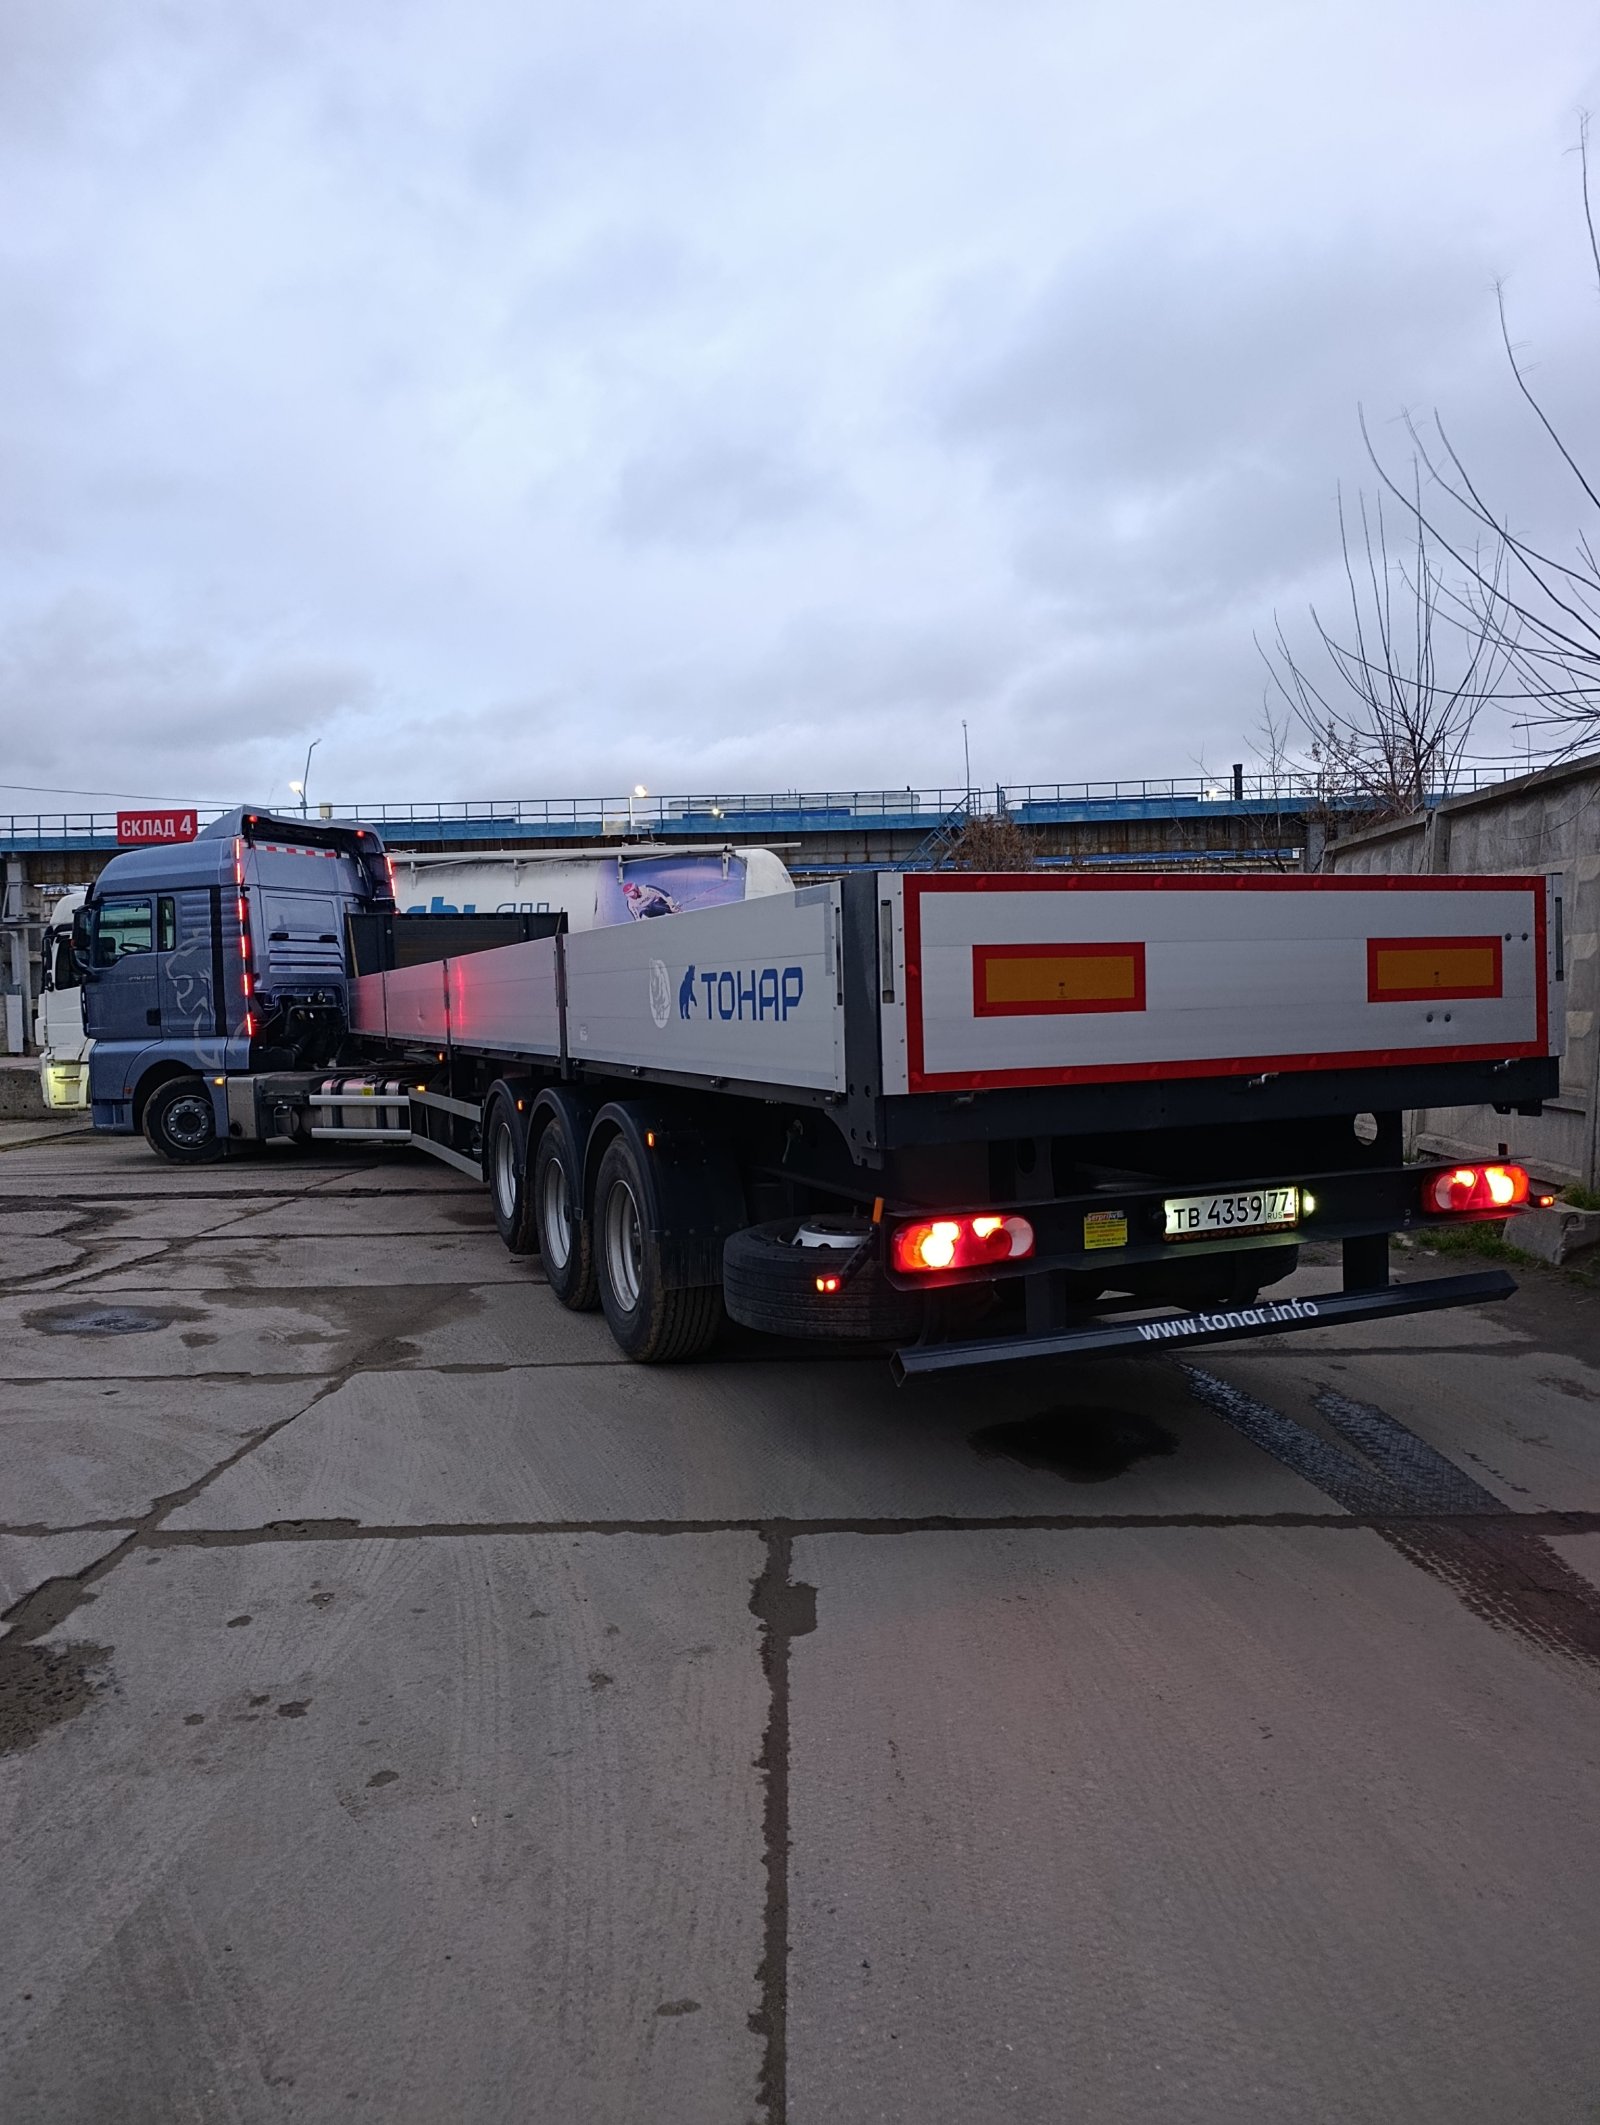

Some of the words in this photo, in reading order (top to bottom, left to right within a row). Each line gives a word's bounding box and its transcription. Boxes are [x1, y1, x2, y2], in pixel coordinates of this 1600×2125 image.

[121, 819, 176, 837] СКЛАД
[180, 815, 193, 835] 4
[701, 967, 803, 1021] ТОНАР
[1207, 1196, 1262, 1225] 4359
[1267, 1191, 1289, 1213] 77
[1267, 1211, 1283, 1220] RUS
[1137, 1298, 1319, 1341] www.tonar.info
